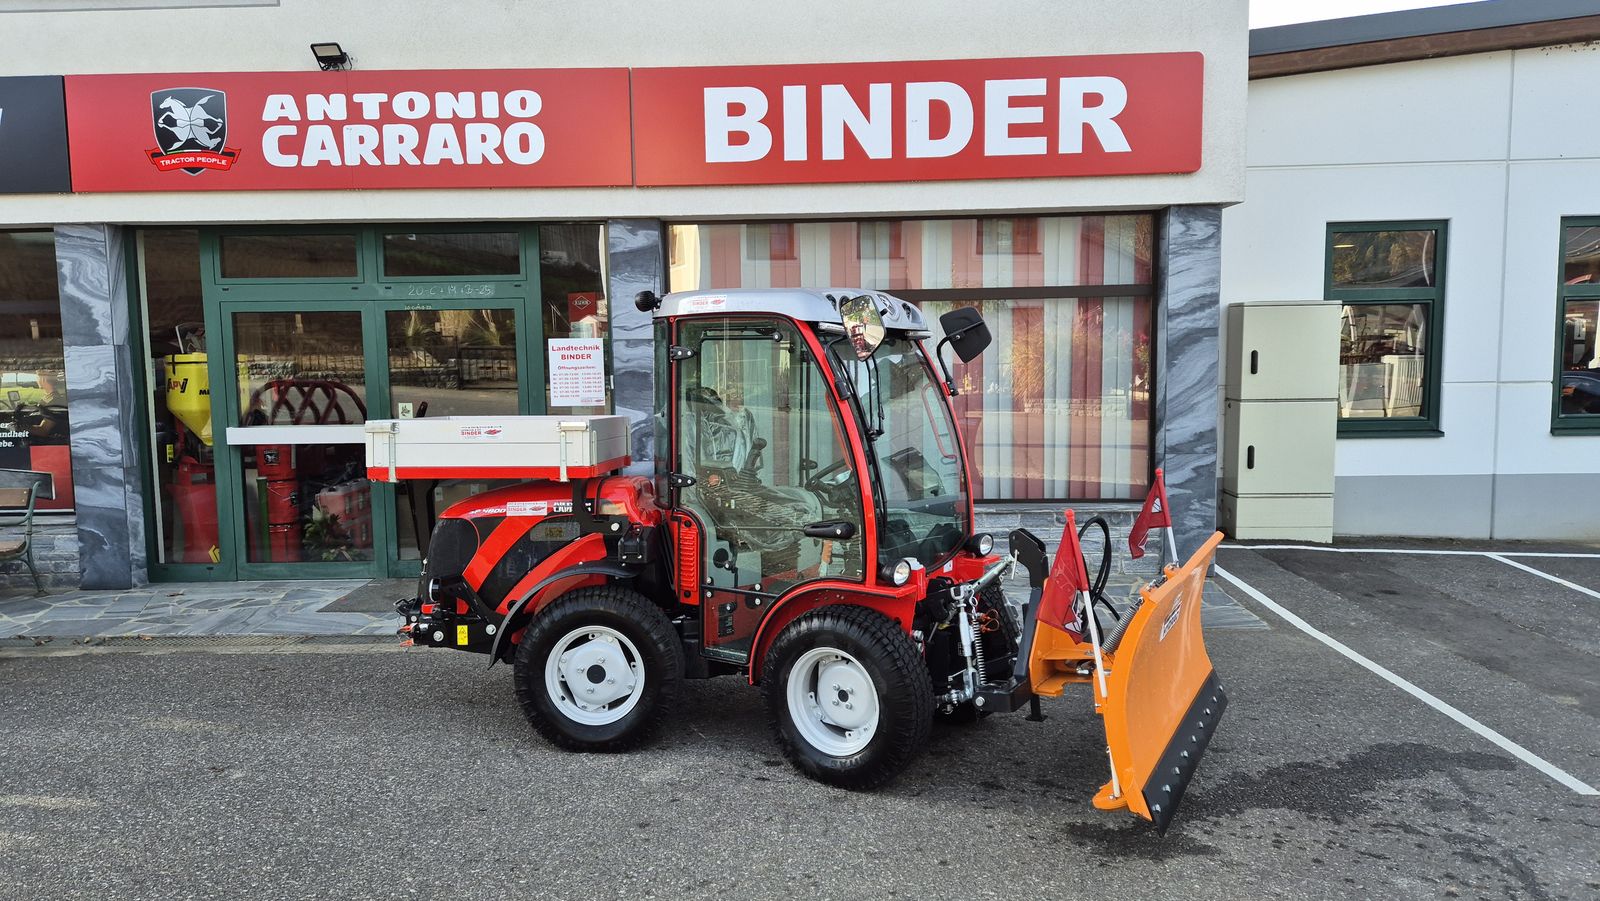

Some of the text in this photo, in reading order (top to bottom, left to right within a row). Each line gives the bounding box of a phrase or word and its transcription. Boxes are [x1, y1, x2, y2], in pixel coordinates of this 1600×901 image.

[262, 90, 542, 121] ANTONIO
[704, 76, 1132, 163] BINDER
[160, 156, 227, 166] TRACTOR PEOPLE
[262, 122, 545, 167] CARRARO
